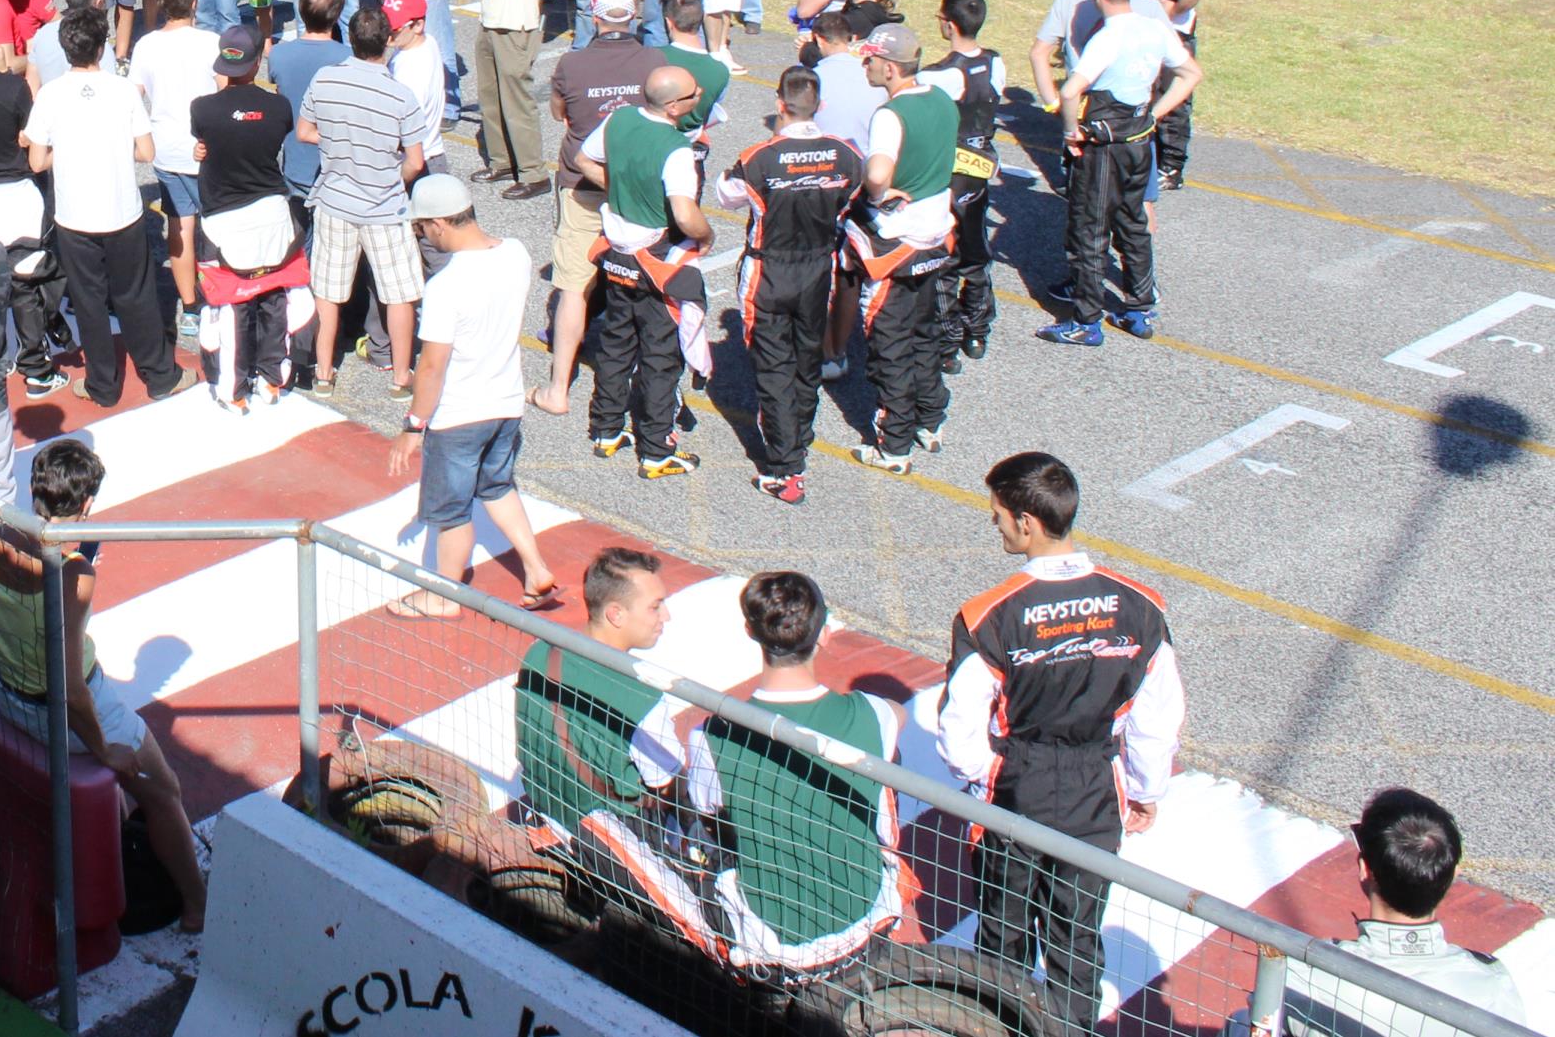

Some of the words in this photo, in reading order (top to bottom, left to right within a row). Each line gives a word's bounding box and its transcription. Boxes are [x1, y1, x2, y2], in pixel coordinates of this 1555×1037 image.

[587, 84, 641, 98] KEYSTONE
[778, 149, 837, 164] KEYSTONE
[956, 151, 991, 174] GAS
[1024, 594, 1119, 625] KEYSTONE
[1036, 621, 1085, 639] Sporting
[1086, 616, 1115, 631] Kart
[1007, 648, 1047, 666] Top
